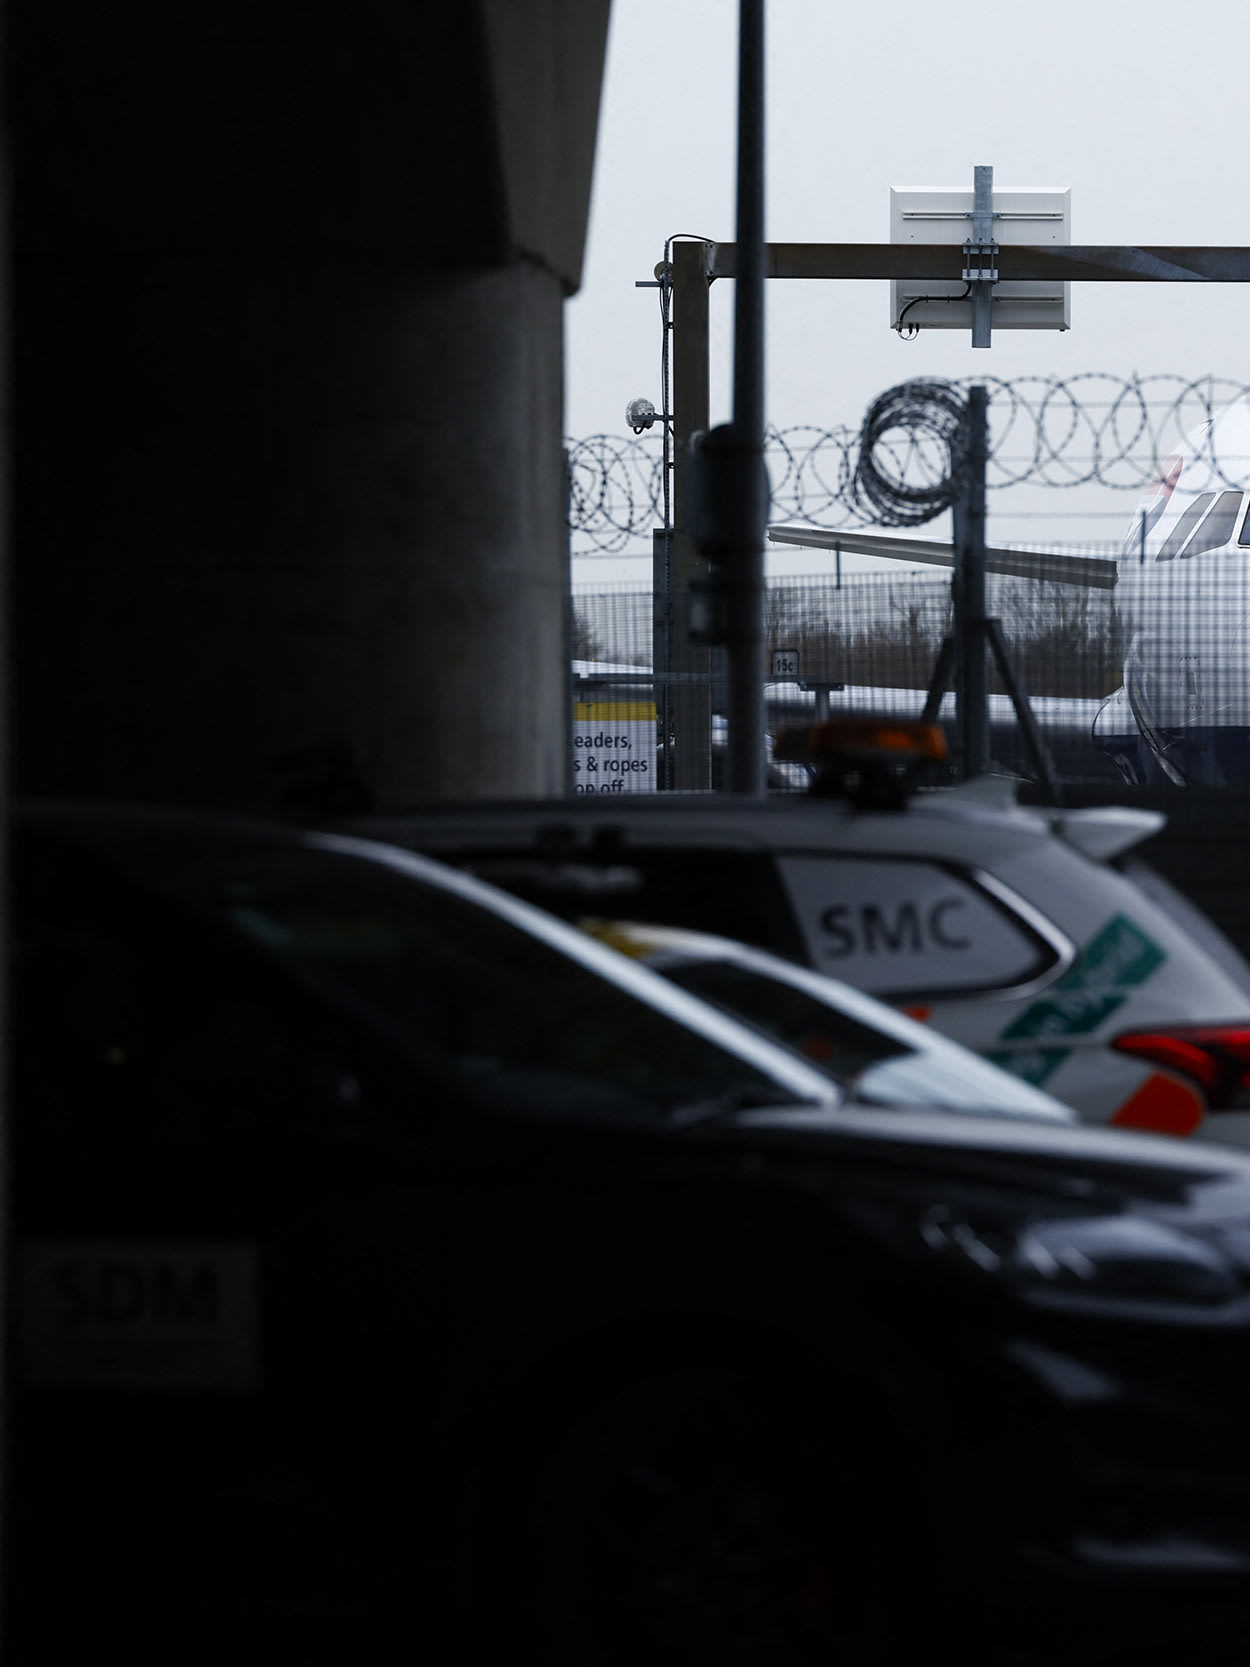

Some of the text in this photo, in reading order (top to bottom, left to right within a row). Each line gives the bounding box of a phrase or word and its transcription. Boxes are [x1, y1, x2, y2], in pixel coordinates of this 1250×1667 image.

[574, 731, 632, 750] eaders,
[587, 756, 598, 772] &
[603, 759, 648, 776] ropes
[600, 779, 624, 793] off
[820, 897, 972, 957] SMC
